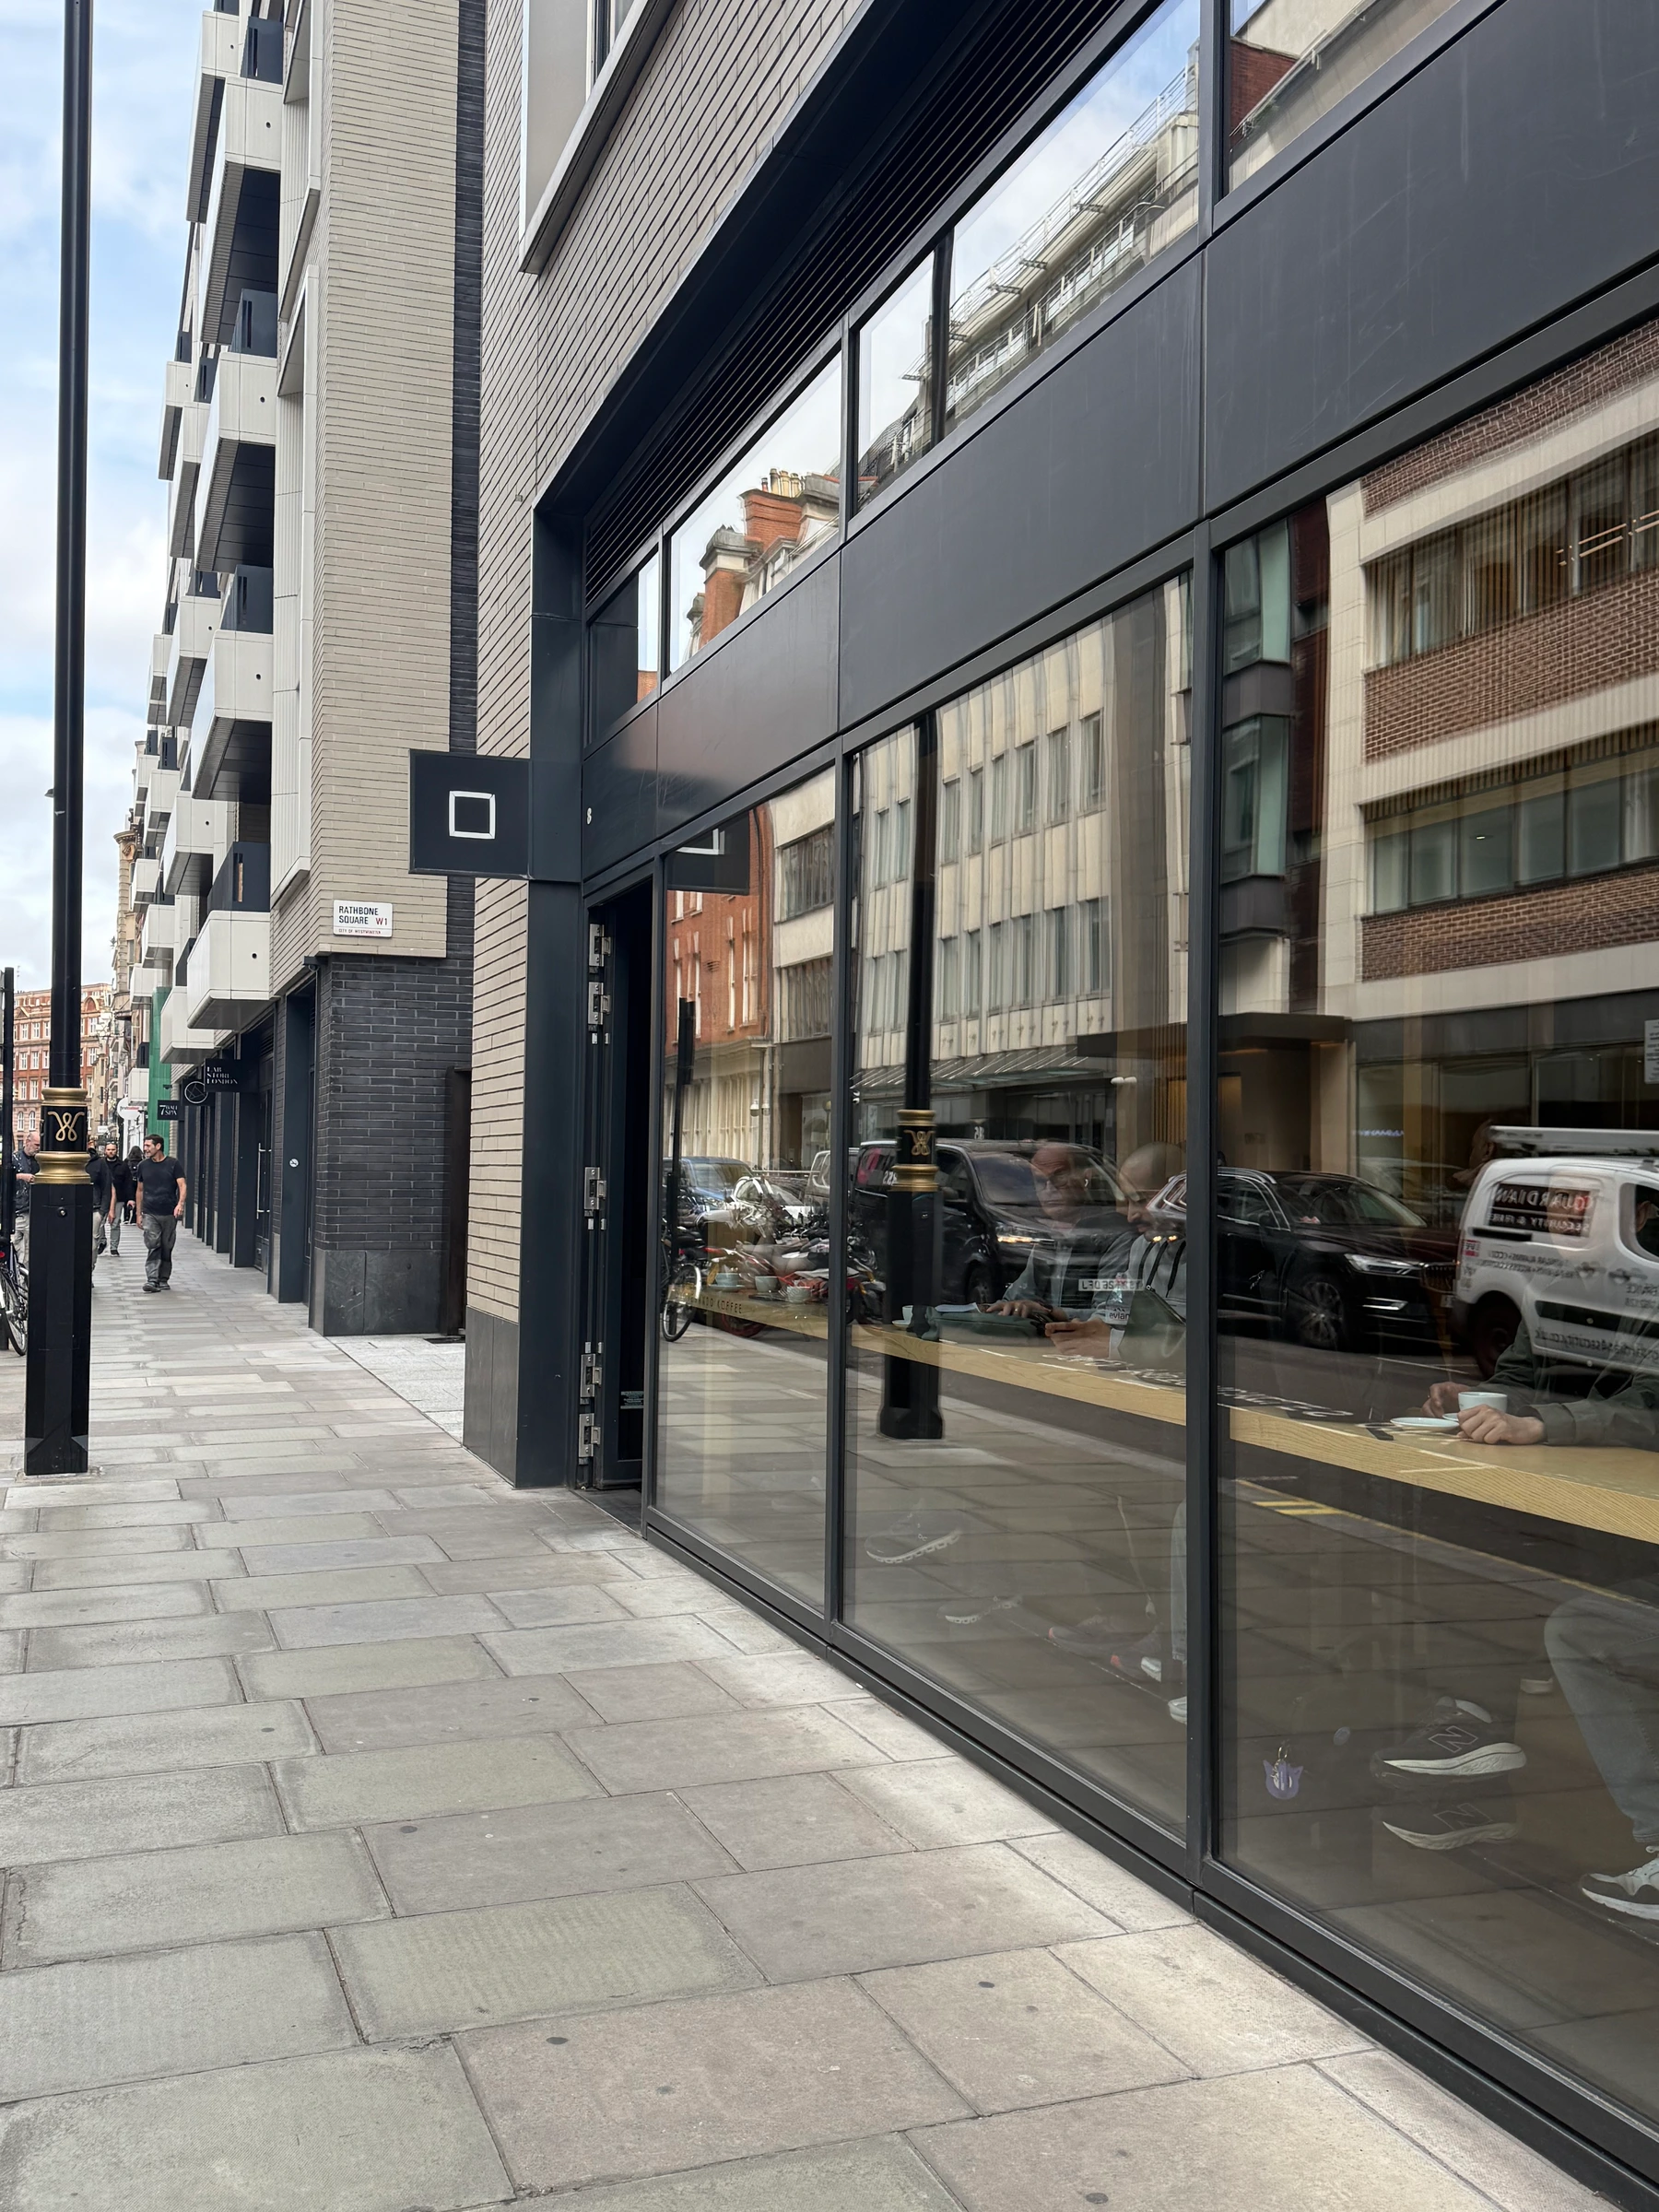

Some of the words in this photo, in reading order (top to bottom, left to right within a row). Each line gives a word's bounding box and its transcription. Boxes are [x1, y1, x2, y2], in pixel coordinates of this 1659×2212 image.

[338, 905, 380, 916] RATHBONE
[338, 915, 369, 925] SQUARE
[375, 917, 388, 925] W1
